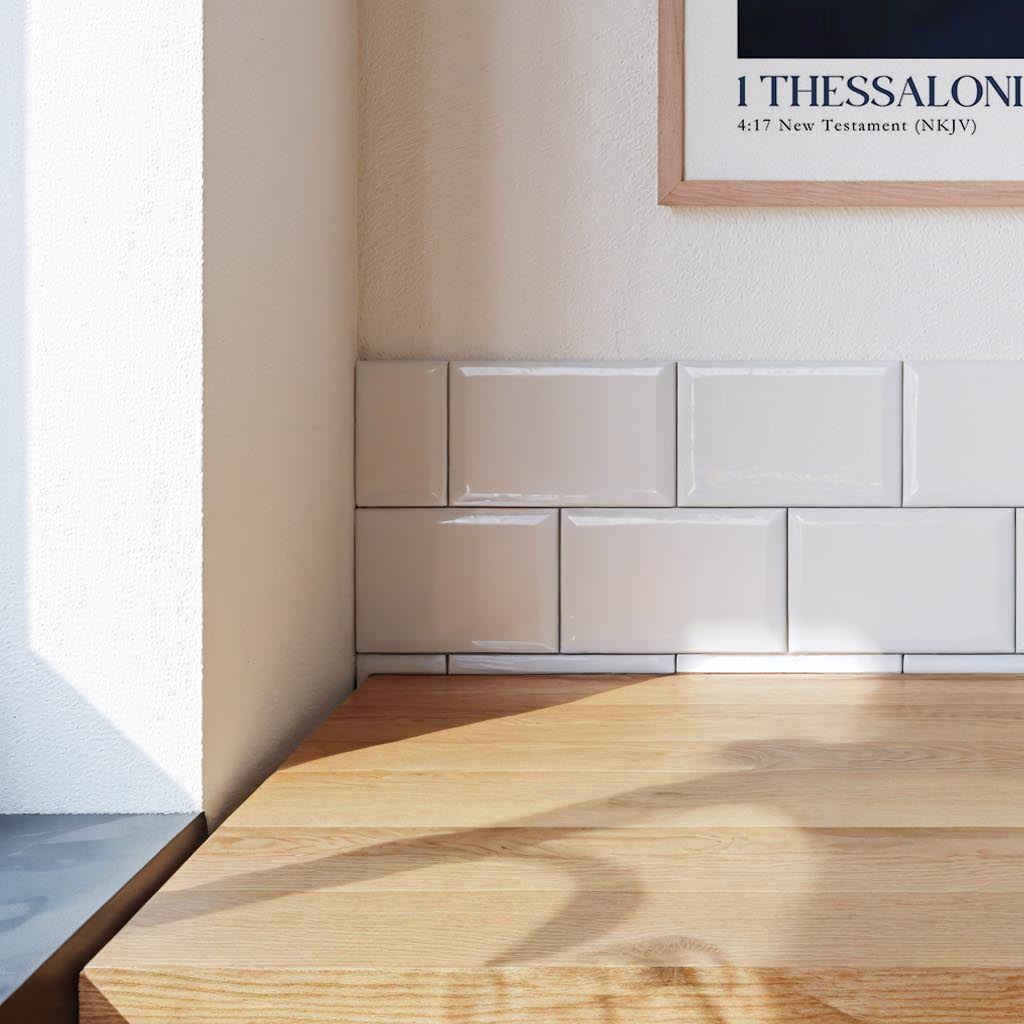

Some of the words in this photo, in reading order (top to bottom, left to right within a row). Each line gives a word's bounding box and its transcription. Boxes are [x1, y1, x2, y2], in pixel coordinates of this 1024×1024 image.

[737, 76, 748, 107] 1
[738, 119, 771, 131] 4:17
[779, 118, 815, 131] New
[821, 118, 908, 131] Testament
[915, 119, 976, 135] (NKJV)
